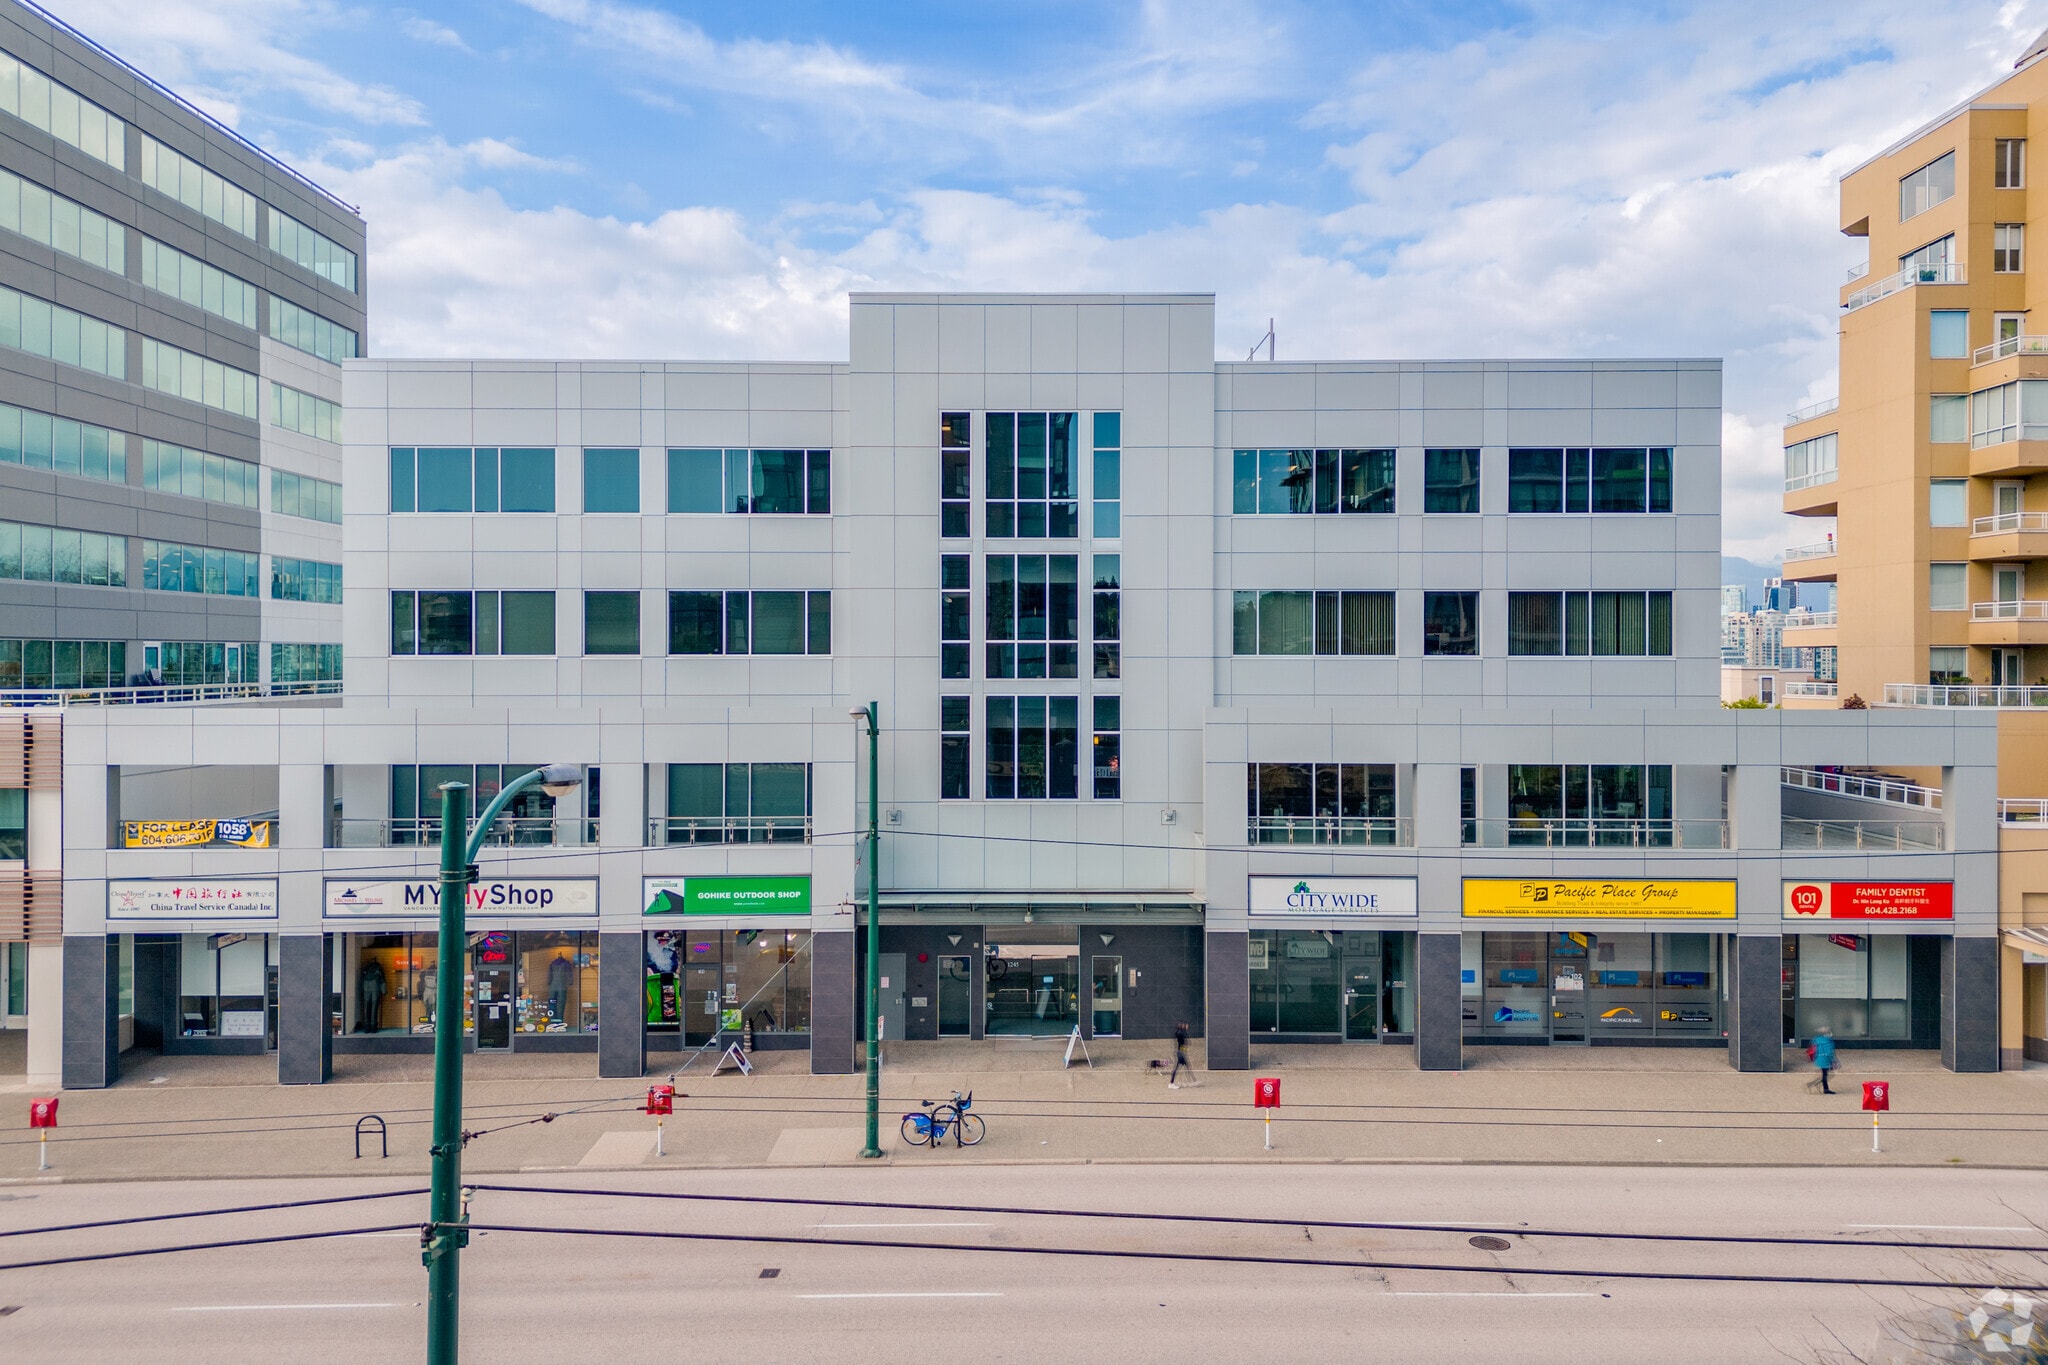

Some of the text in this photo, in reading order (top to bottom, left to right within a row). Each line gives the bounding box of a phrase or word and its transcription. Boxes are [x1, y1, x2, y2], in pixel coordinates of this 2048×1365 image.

[142, 823, 168, 833] FOR
[1554, 884, 1678, 901] Pacific Place Group
[1856, 888, 1926, 896] FAMILY DENTIST
[1287, 894, 1378, 908] CITY WIDE
[1796, 892, 1816, 904] 101
[150, 903, 172, 911] China
[175, 903, 197, 911] Travel
[227, 902, 258, 911] (Canada)
[483, 951, 506, 961] Open
